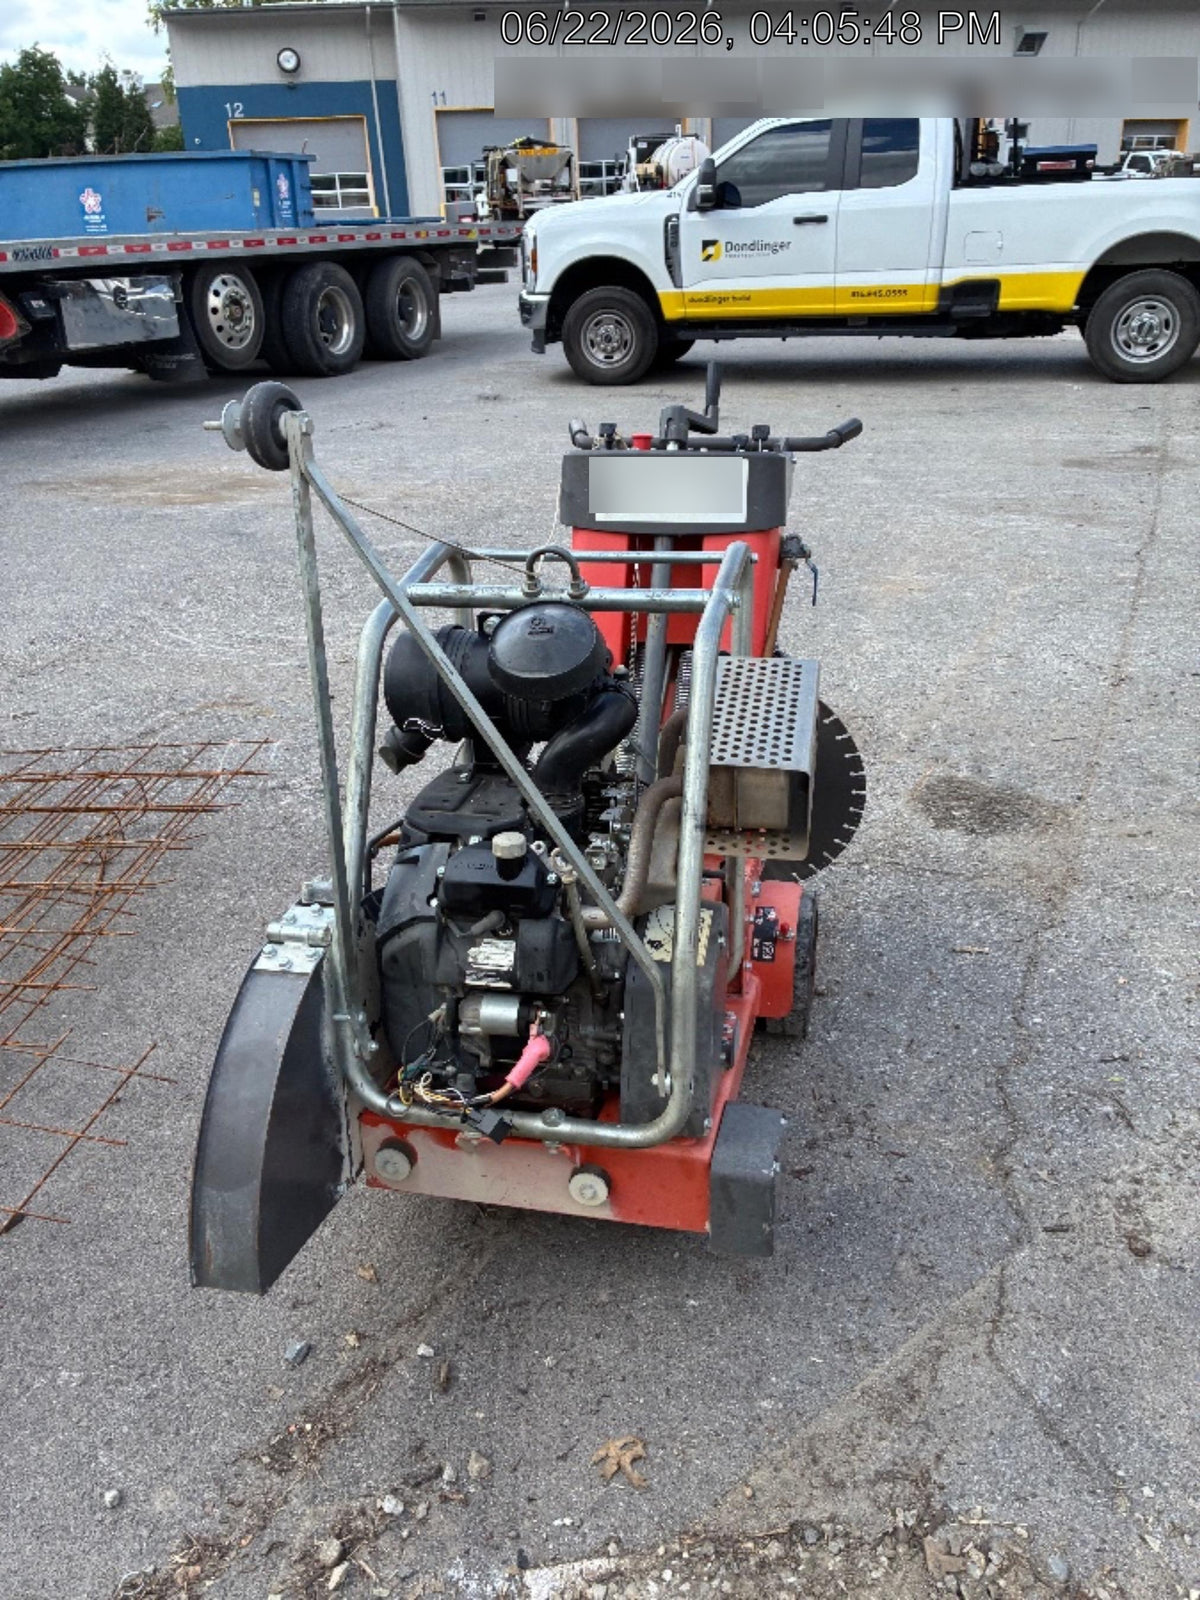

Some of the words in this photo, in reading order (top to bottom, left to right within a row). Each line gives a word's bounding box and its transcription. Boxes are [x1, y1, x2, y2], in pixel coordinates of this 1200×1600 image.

[431, 91, 447, 106] 11
[224, 102, 245, 118] 12
[724, 240, 792, 255] Dondlinger
